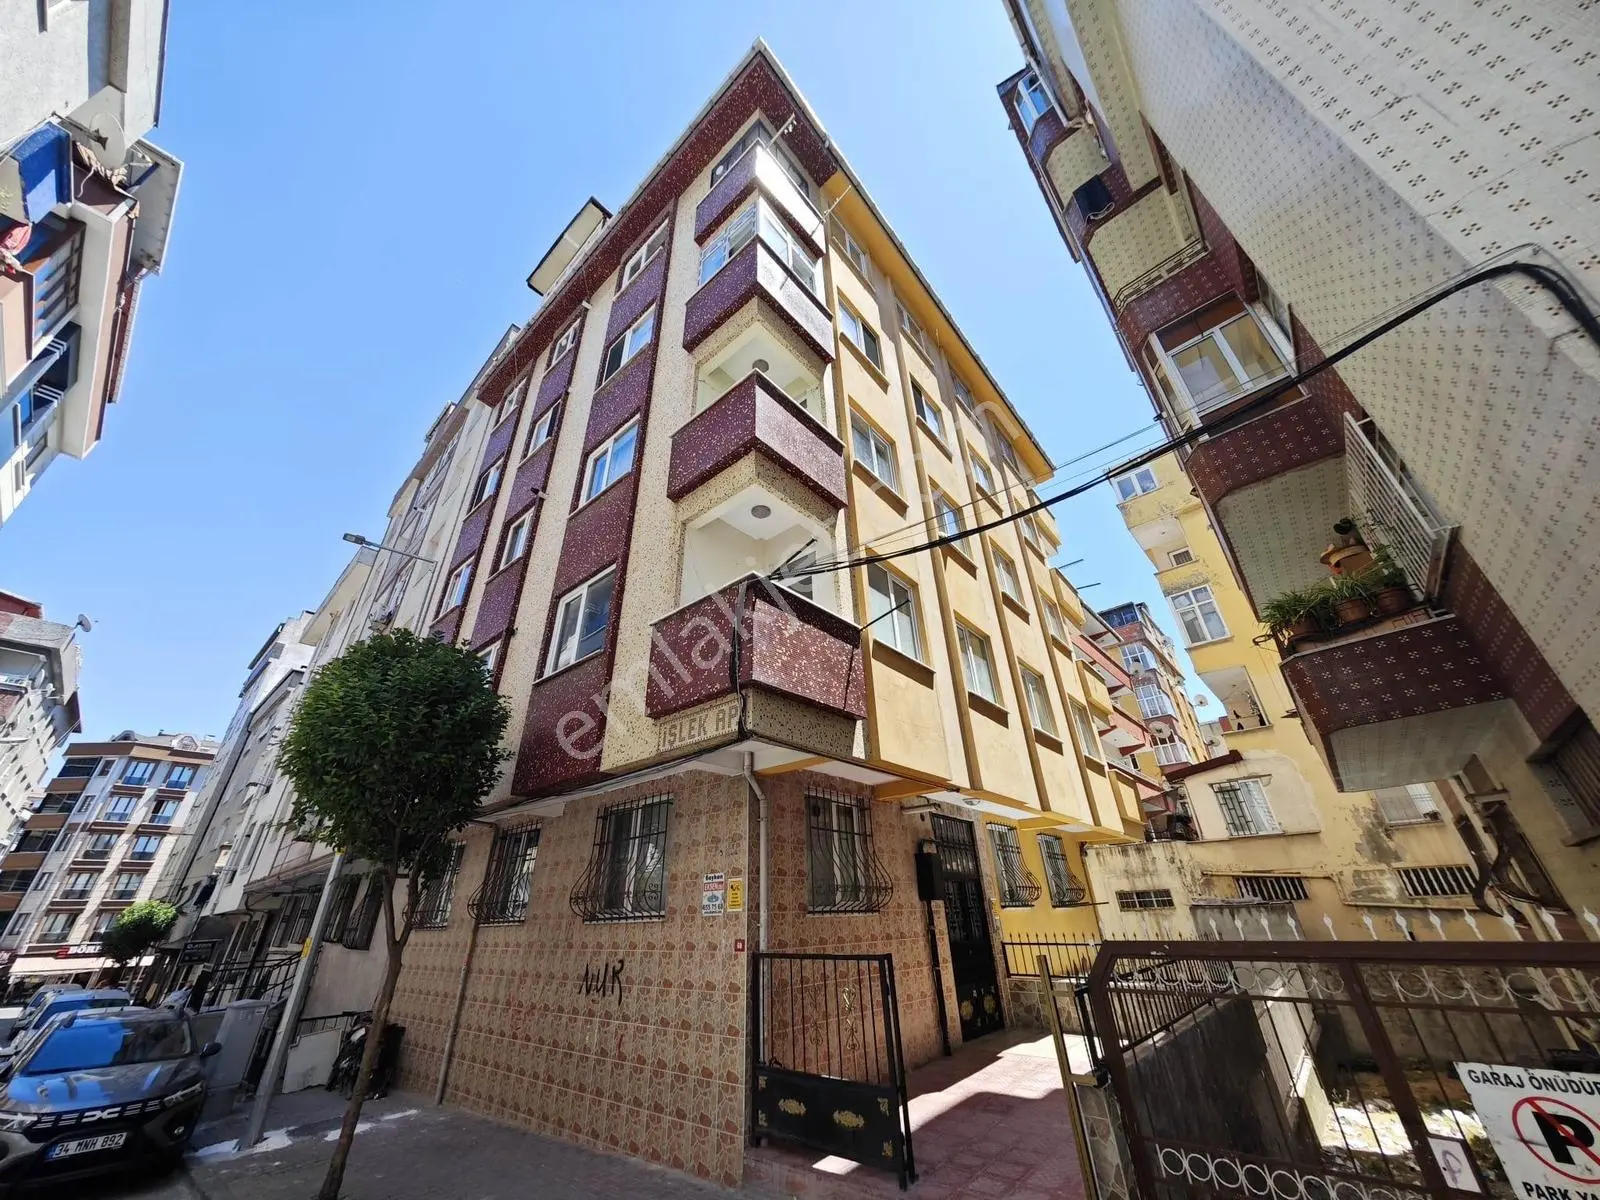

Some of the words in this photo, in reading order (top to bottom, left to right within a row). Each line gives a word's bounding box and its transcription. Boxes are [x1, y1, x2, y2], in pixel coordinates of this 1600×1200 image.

[715, 705, 738, 732] AP
[578, 959, 624, 1006] NUR
[1468, 1069, 1525, 1088] GARAJ
[57, 1143, 69, 1155] 34
[101, 1134, 123, 1147] 892
[1522, 1181, 1572, 1200] PARK
